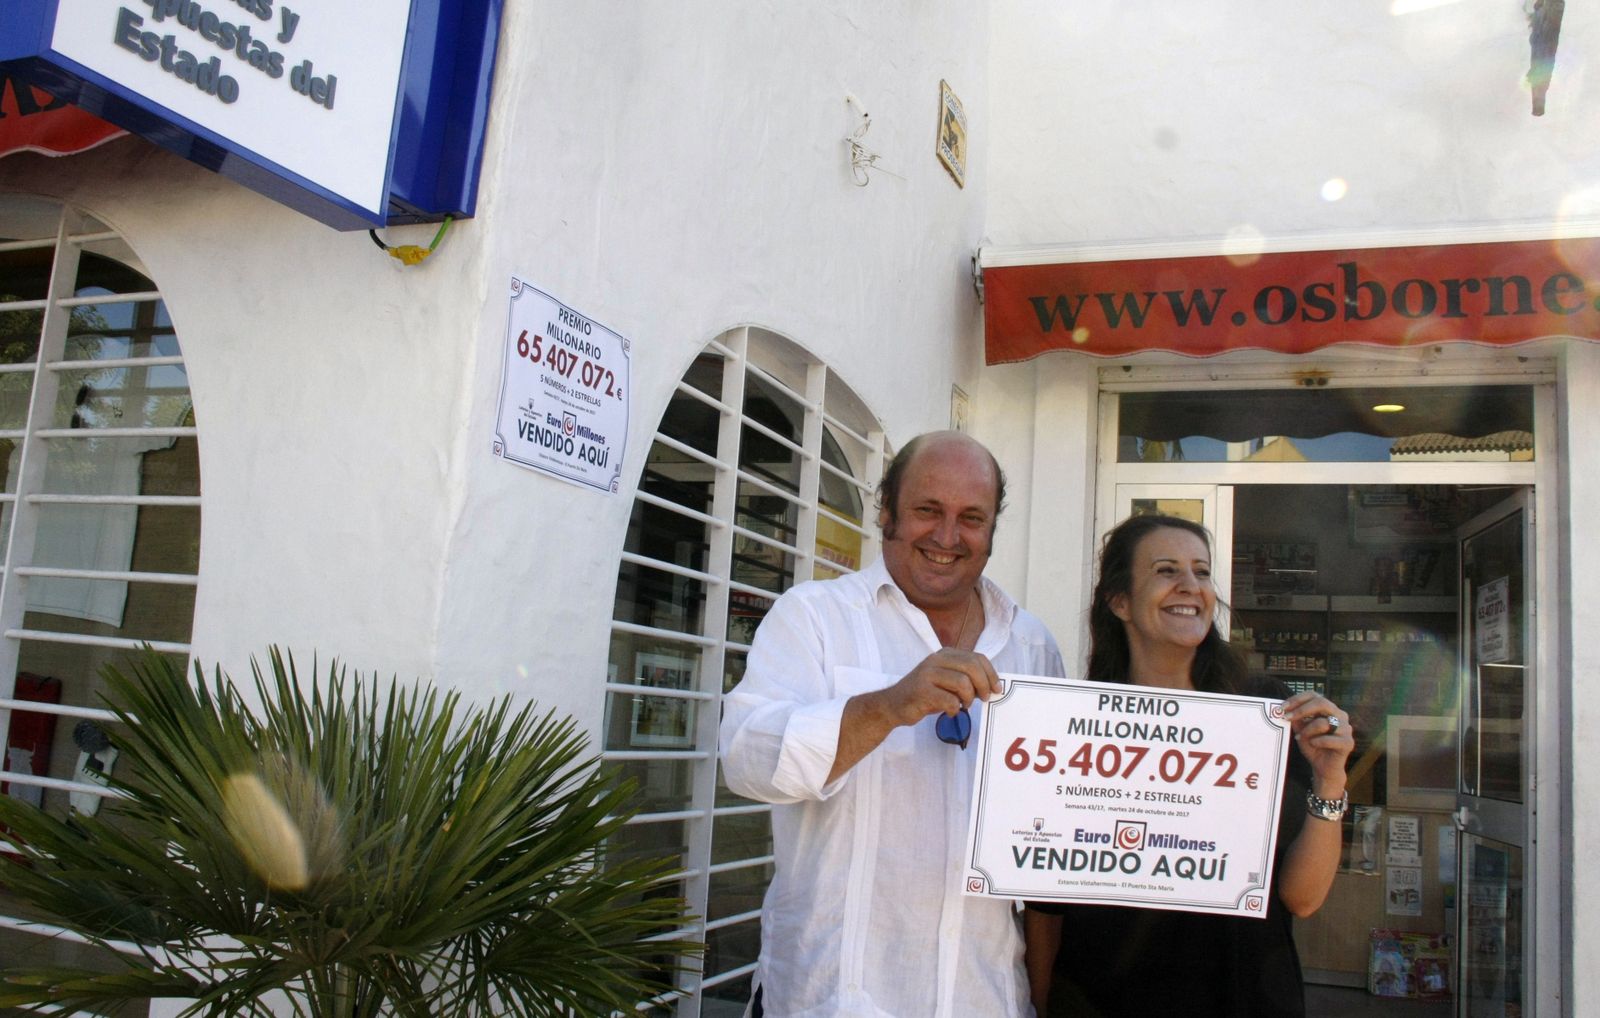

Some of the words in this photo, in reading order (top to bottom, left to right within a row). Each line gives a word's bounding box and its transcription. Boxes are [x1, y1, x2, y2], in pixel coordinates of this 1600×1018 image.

[114, 6, 240, 104] Estado
[142, 0, 284, 79] puestas
[290, 59, 338, 110] del
[558, 307, 592, 336] PREMIO
[546, 321, 601, 360] MILLONARIO
[517, 329, 614, 397] 65.407.072
[575, 390, 601, 407] ESTRELLAS
[517, 418, 574, 457] VENDIDO
[578, 442, 610, 469] AQUÍ
[547, 412, 562, 428] Euro
[576, 424, 606, 446] Millones
[1097, 694, 1180, 718] PREMIO
[1067, 717, 1204, 745] MILLONARIO
[1004, 736, 1239, 789] 65.407.072
[1056, 785, 1063, 796] 5
[1065, 784, 1122, 799] NÚMEROS
[1134, 790, 1141, 800] 2
[1144, 790, 1203, 806] ESTRELLAS
[1144, 808, 1166, 816] octubre
[1176, 810, 1190, 818] 2017
[1074, 828, 1111, 844] Euro
[1148, 833, 1216, 852] Millones
[1011, 845, 1142, 874] VENDIDO
[1151, 853, 1229, 882] AQUÍ
[1128, 882, 1147, 890] Puerto
